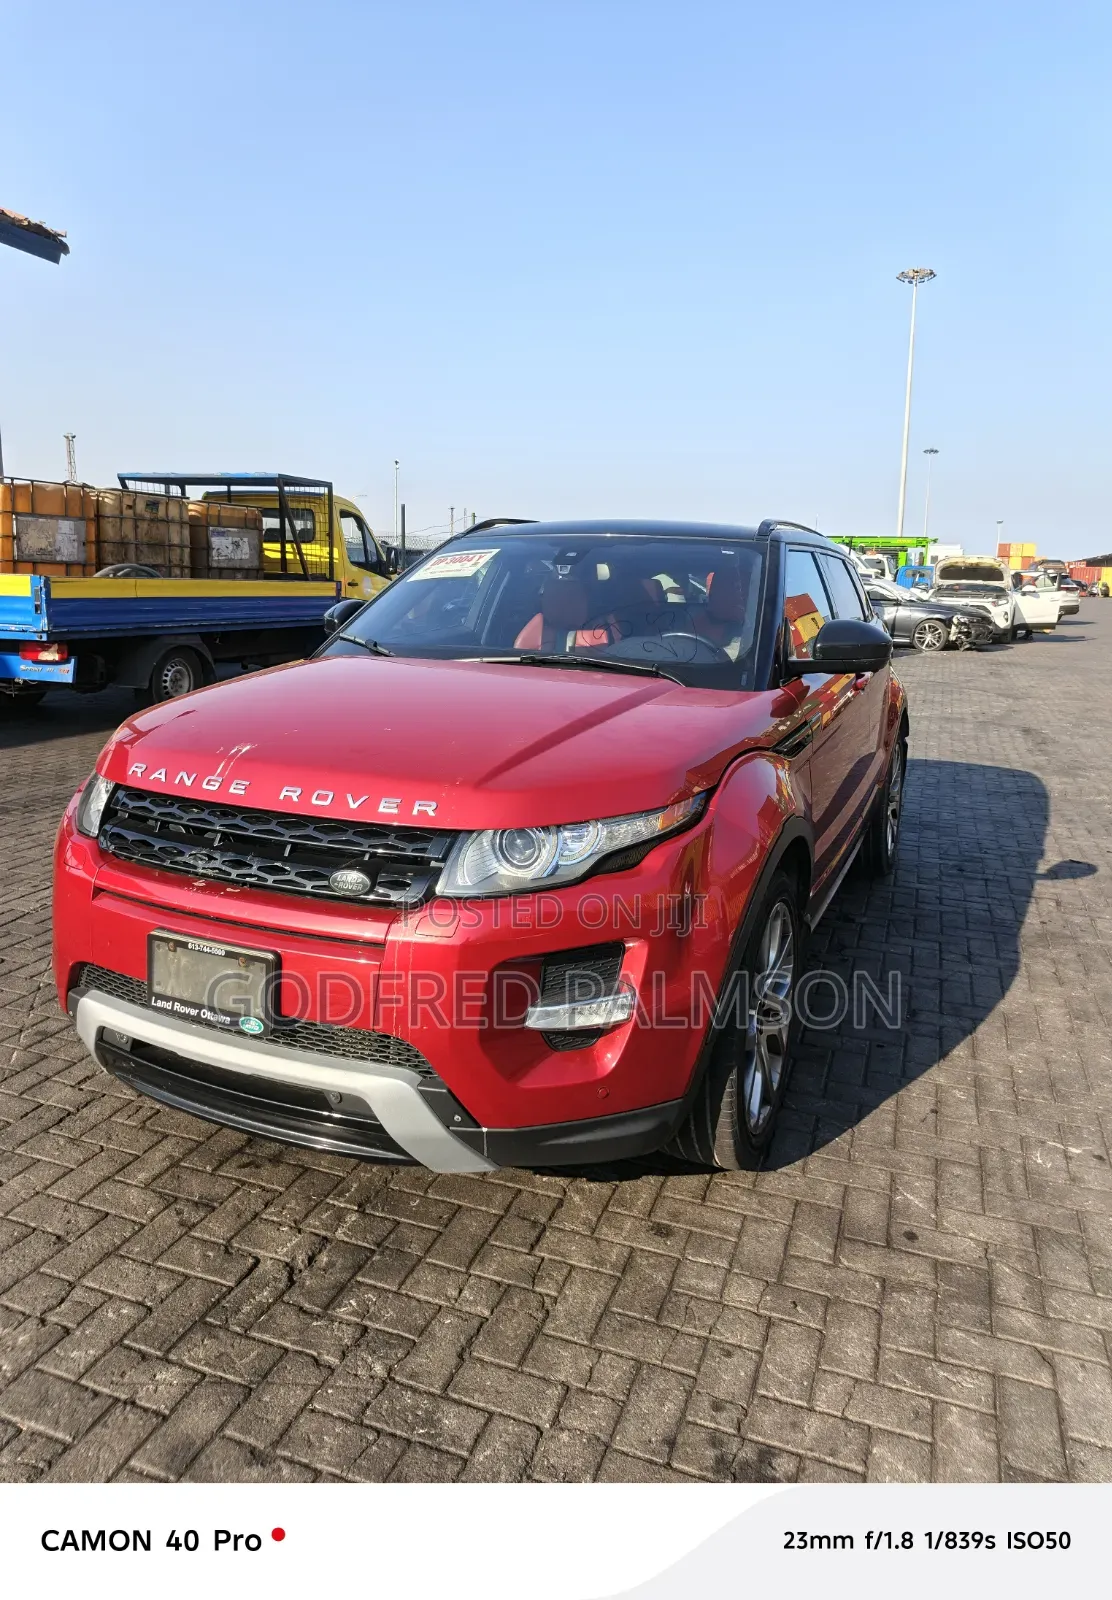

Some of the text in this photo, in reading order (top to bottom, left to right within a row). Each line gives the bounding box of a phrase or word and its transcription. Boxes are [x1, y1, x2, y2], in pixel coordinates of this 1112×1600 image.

[128, 763, 438, 817] RANGE ROVER
[336, 874, 358, 883] LAND
[338, 881, 363, 891] ROVER
[151, 996, 173, 1010] Land
[173, 1002, 199, 1016] Rover
[200, 1009, 231, 1025] Ottawa
